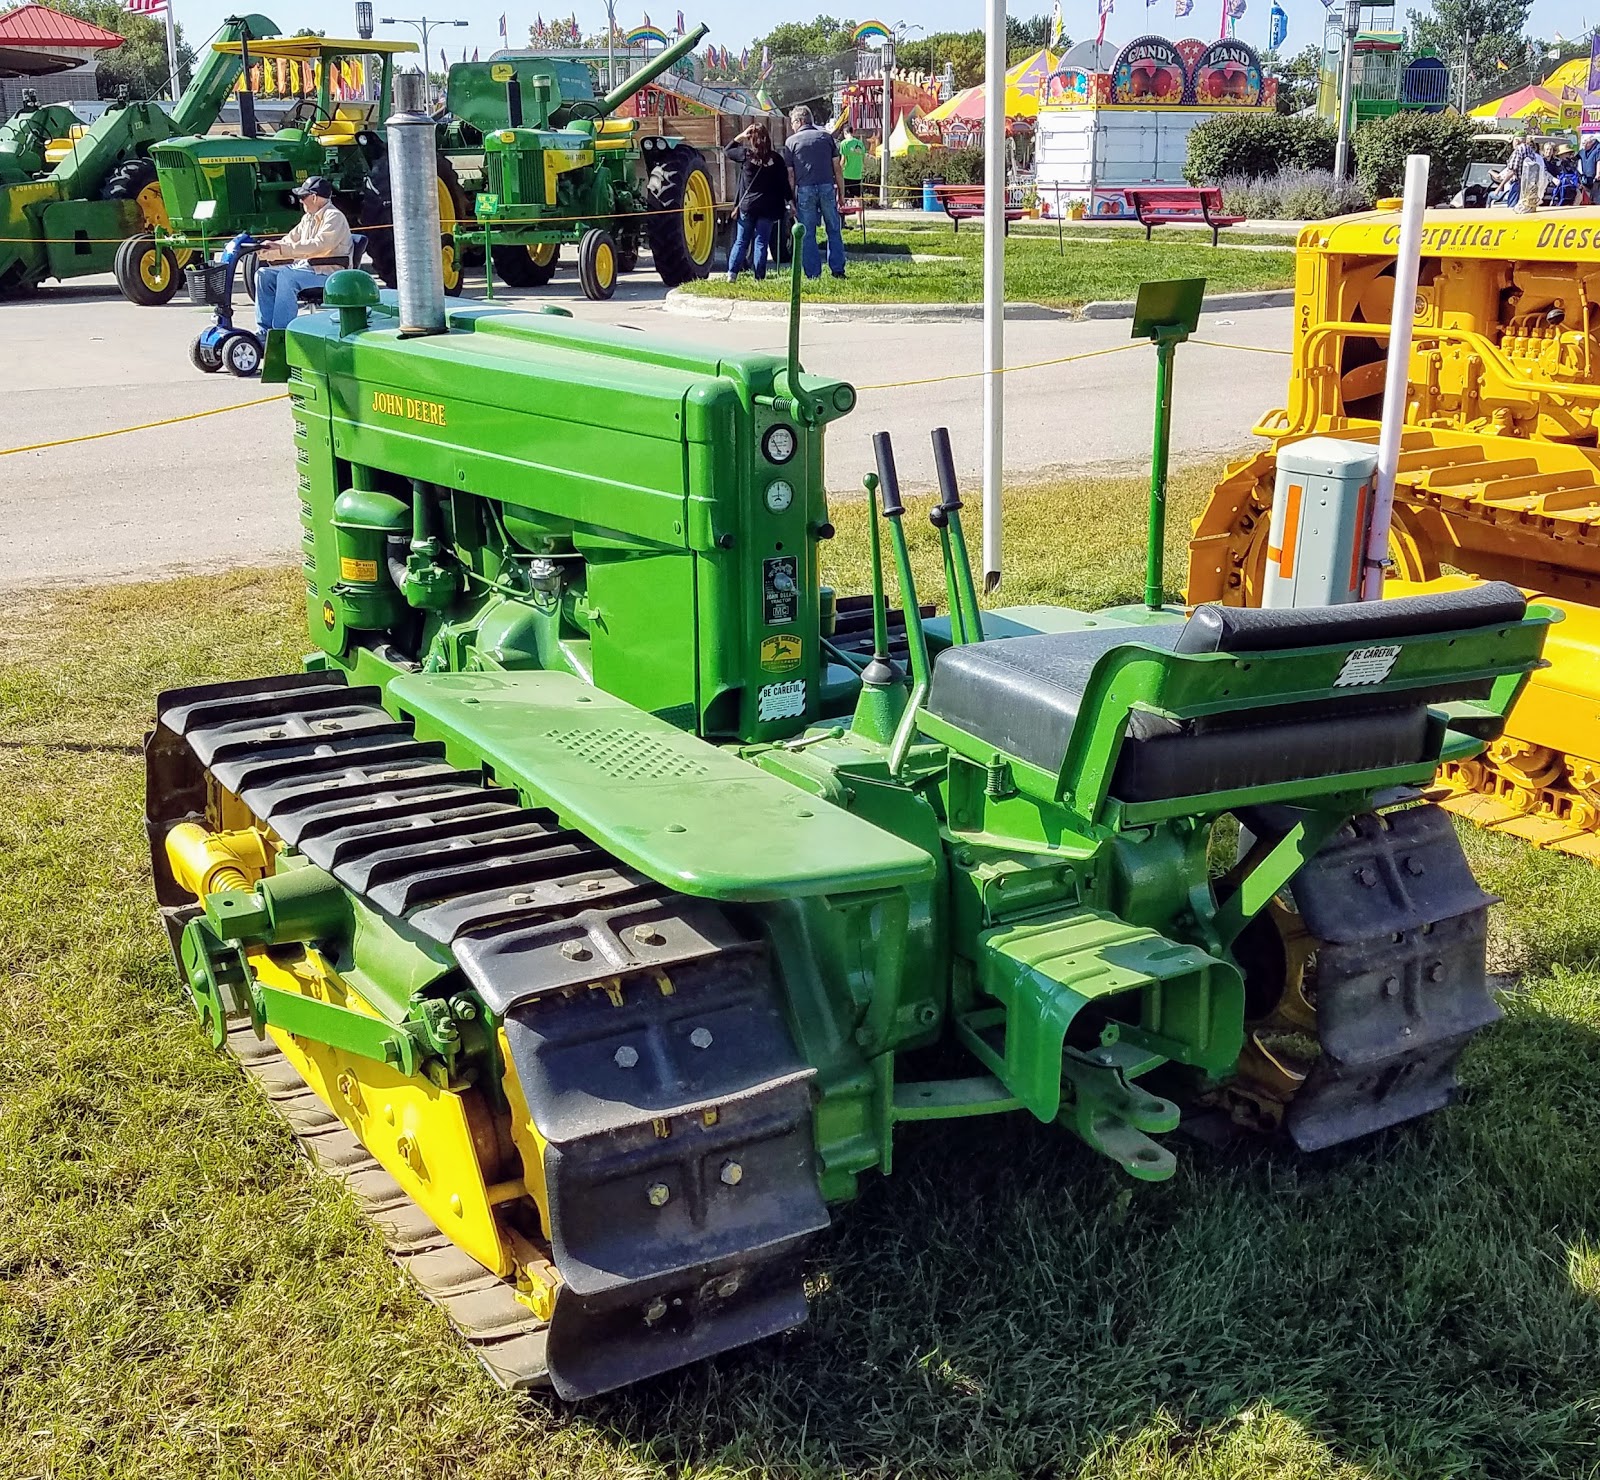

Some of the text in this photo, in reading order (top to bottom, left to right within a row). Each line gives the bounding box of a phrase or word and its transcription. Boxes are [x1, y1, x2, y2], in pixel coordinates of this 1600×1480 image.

[1127, 45, 1250, 66] CANDY LAND
[35, 182, 56, 190] DEERE
[1383, 224, 1507, 250] Cerpillar
[372, 391, 446, 426] JOHN DEERE
[323, 606, 335, 625] MC
[774, 607, 788, 615] MC
[1352, 648, 1395, 660] BE CAREFUL
[763, 684, 801, 698] BE CAREFUL
